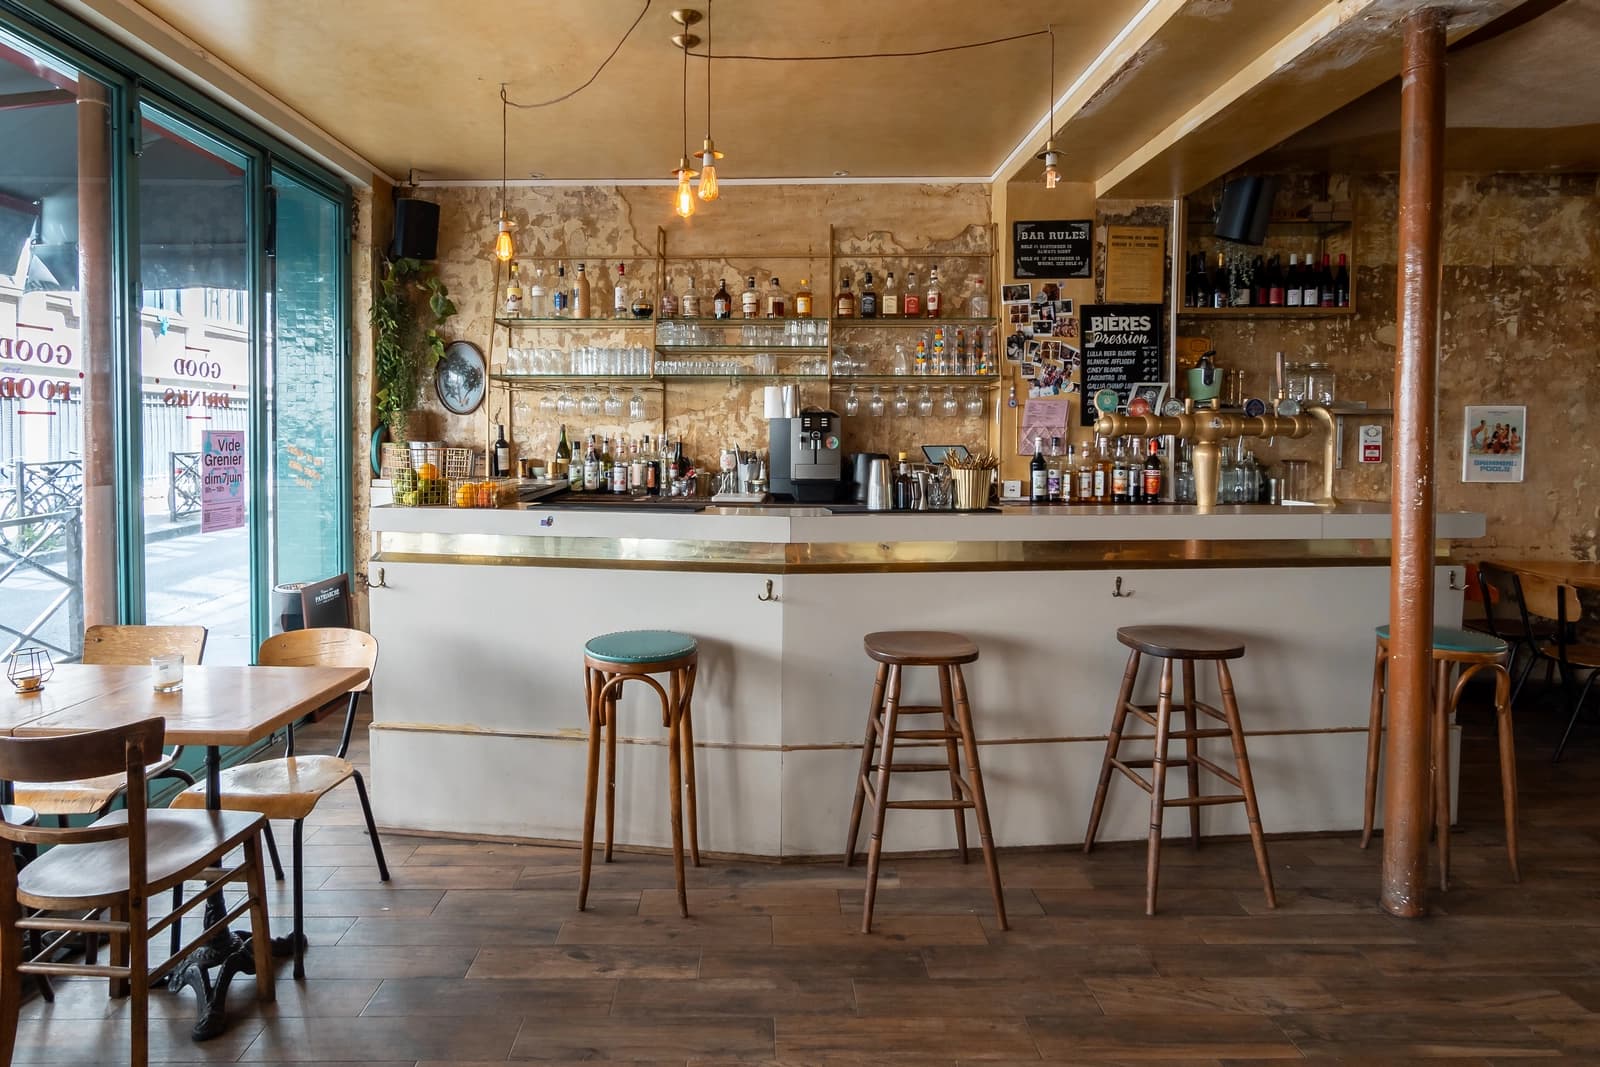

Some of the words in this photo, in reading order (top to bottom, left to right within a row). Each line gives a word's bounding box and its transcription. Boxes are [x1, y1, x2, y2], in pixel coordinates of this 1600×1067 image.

[1021, 231, 1044, 240] BAR
[1049, 231, 1086, 240] RULES
[1091, 312, 1151, 332] BIÈRES
[1095, 332, 1149, 344] Pression
[218, 438, 240, 452] Vide
[204, 454, 242, 466] Grenier
